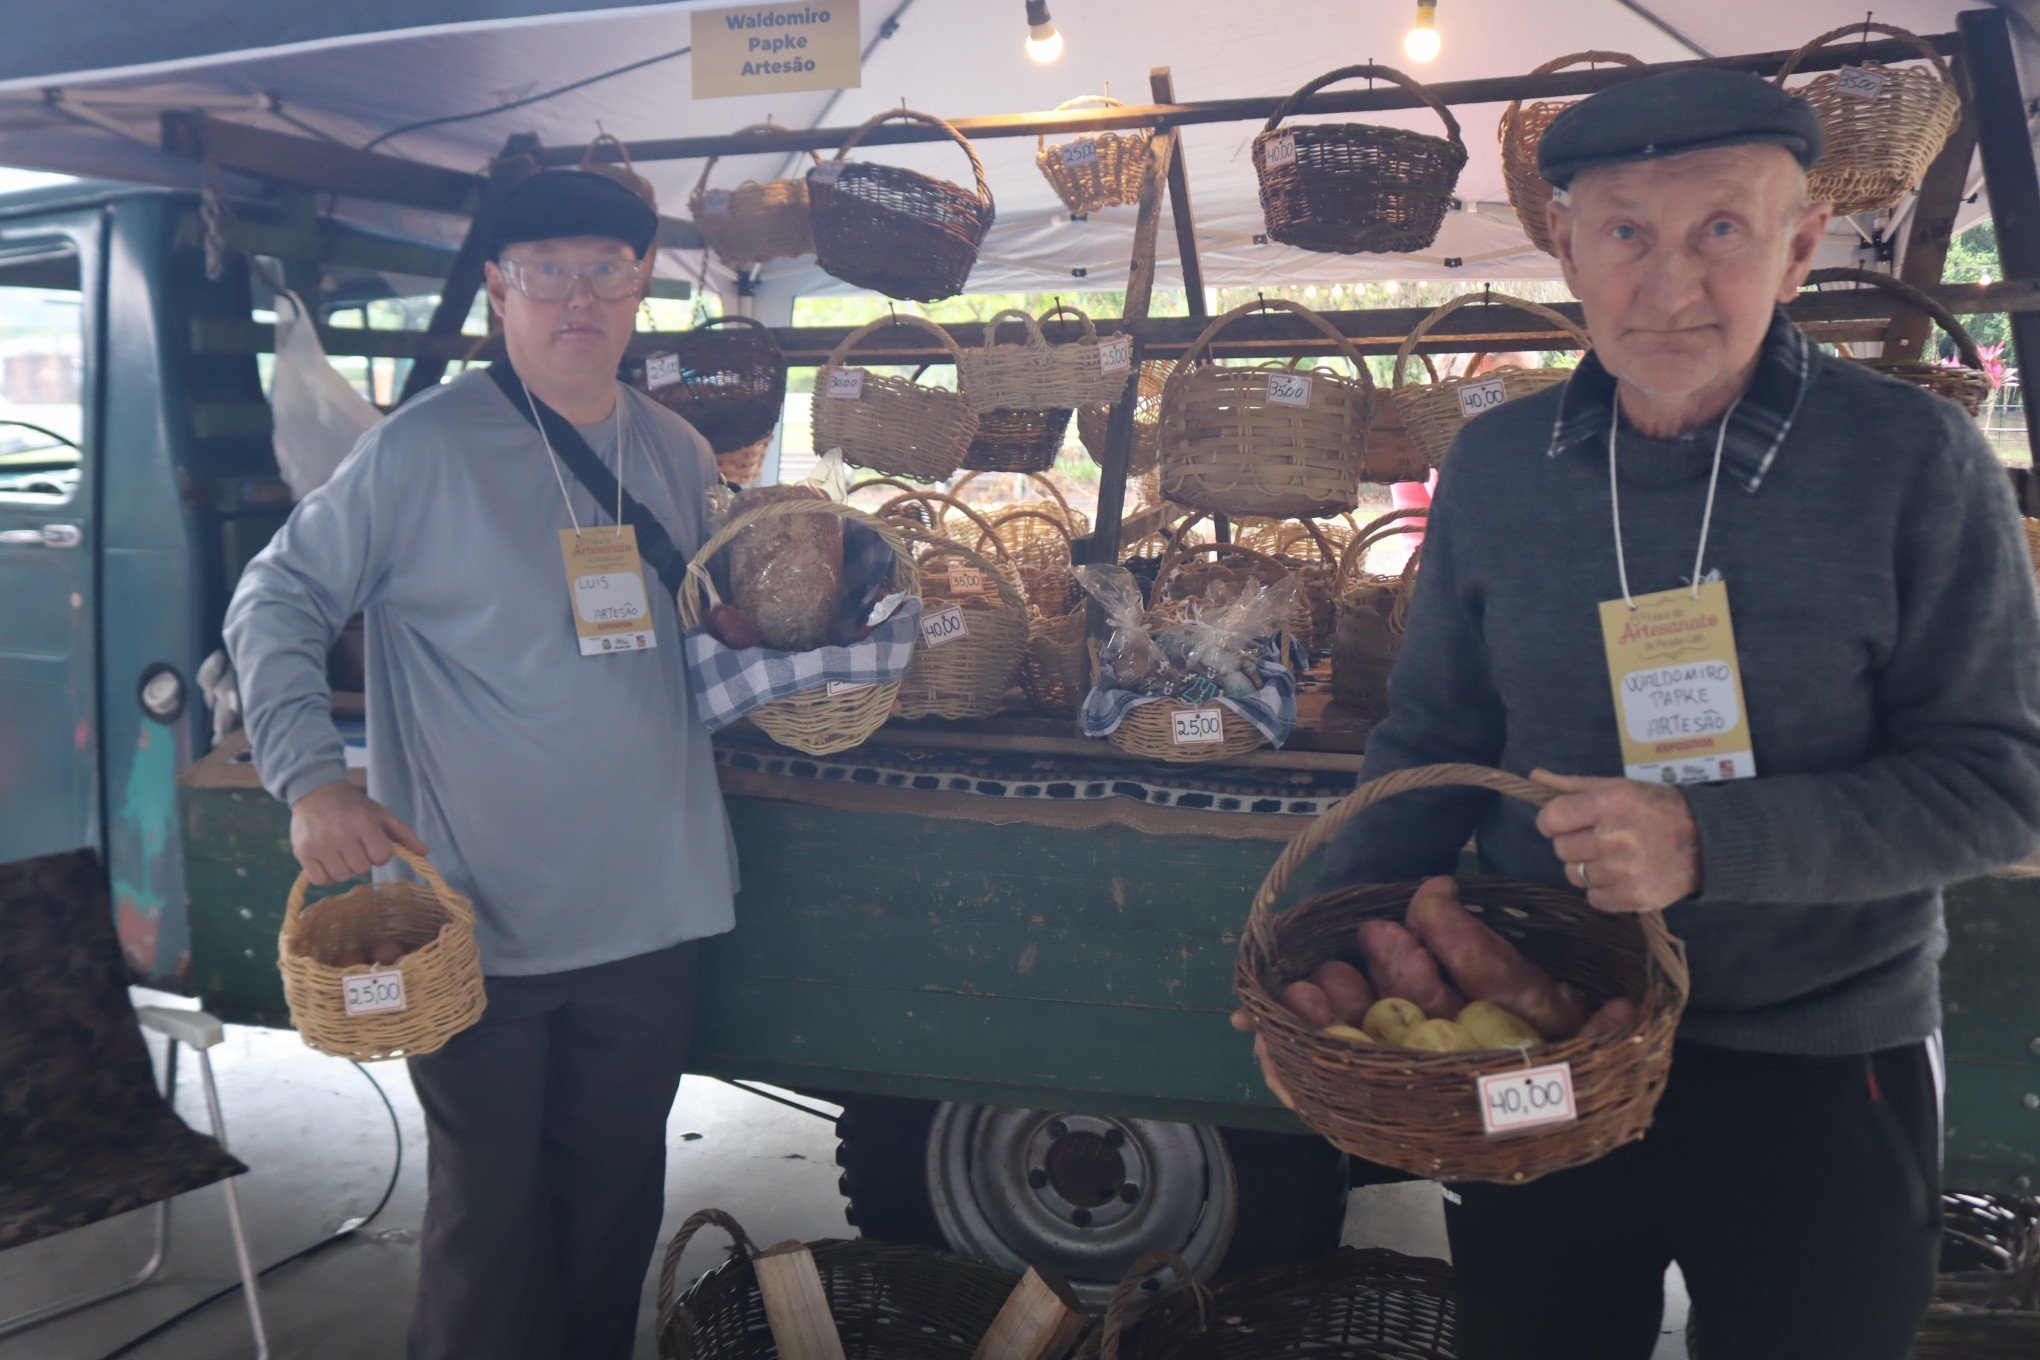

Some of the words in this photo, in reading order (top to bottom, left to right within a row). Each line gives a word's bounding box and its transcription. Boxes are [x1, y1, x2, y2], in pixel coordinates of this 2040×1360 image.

[725, 7, 831, 30] Waldomiro
[748, 33, 808, 54] Papke
[741, 56, 816, 76] Artesão
[1464, 390, 1504, 408] 40,00
[952, 575, 980, 588] 35,00
[925, 616, 960, 637] 40,00
[1618, 614, 1719, 645] Artesanato
[1177, 717, 1219, 737] 25,00
[1647, 708, 1725, 737] ARTESÃO
[348, 982, 400, 1006] 25,00
[1490, 1081, 1564, 1114] 40,00
